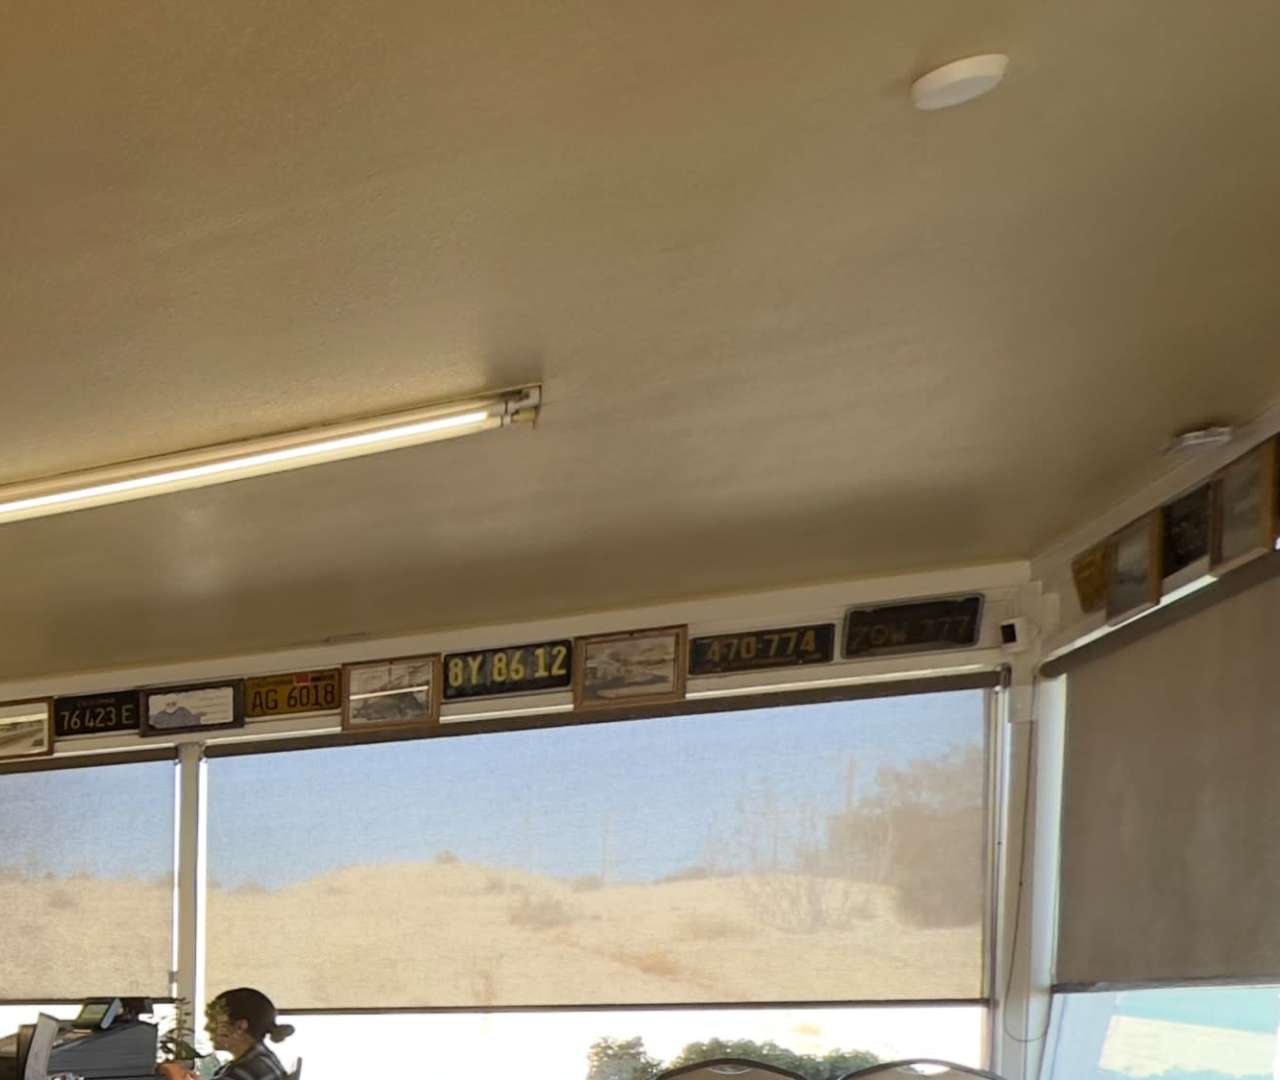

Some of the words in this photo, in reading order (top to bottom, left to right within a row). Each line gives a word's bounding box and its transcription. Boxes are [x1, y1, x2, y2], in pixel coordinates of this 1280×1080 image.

[448, 652, 482, 687] 8Y
[492, 648, 525, 683] 86
[533, 644, 567, 678] 12
[251, 688, 278, 712] AG
[287, 683, 336, 708] 6018
